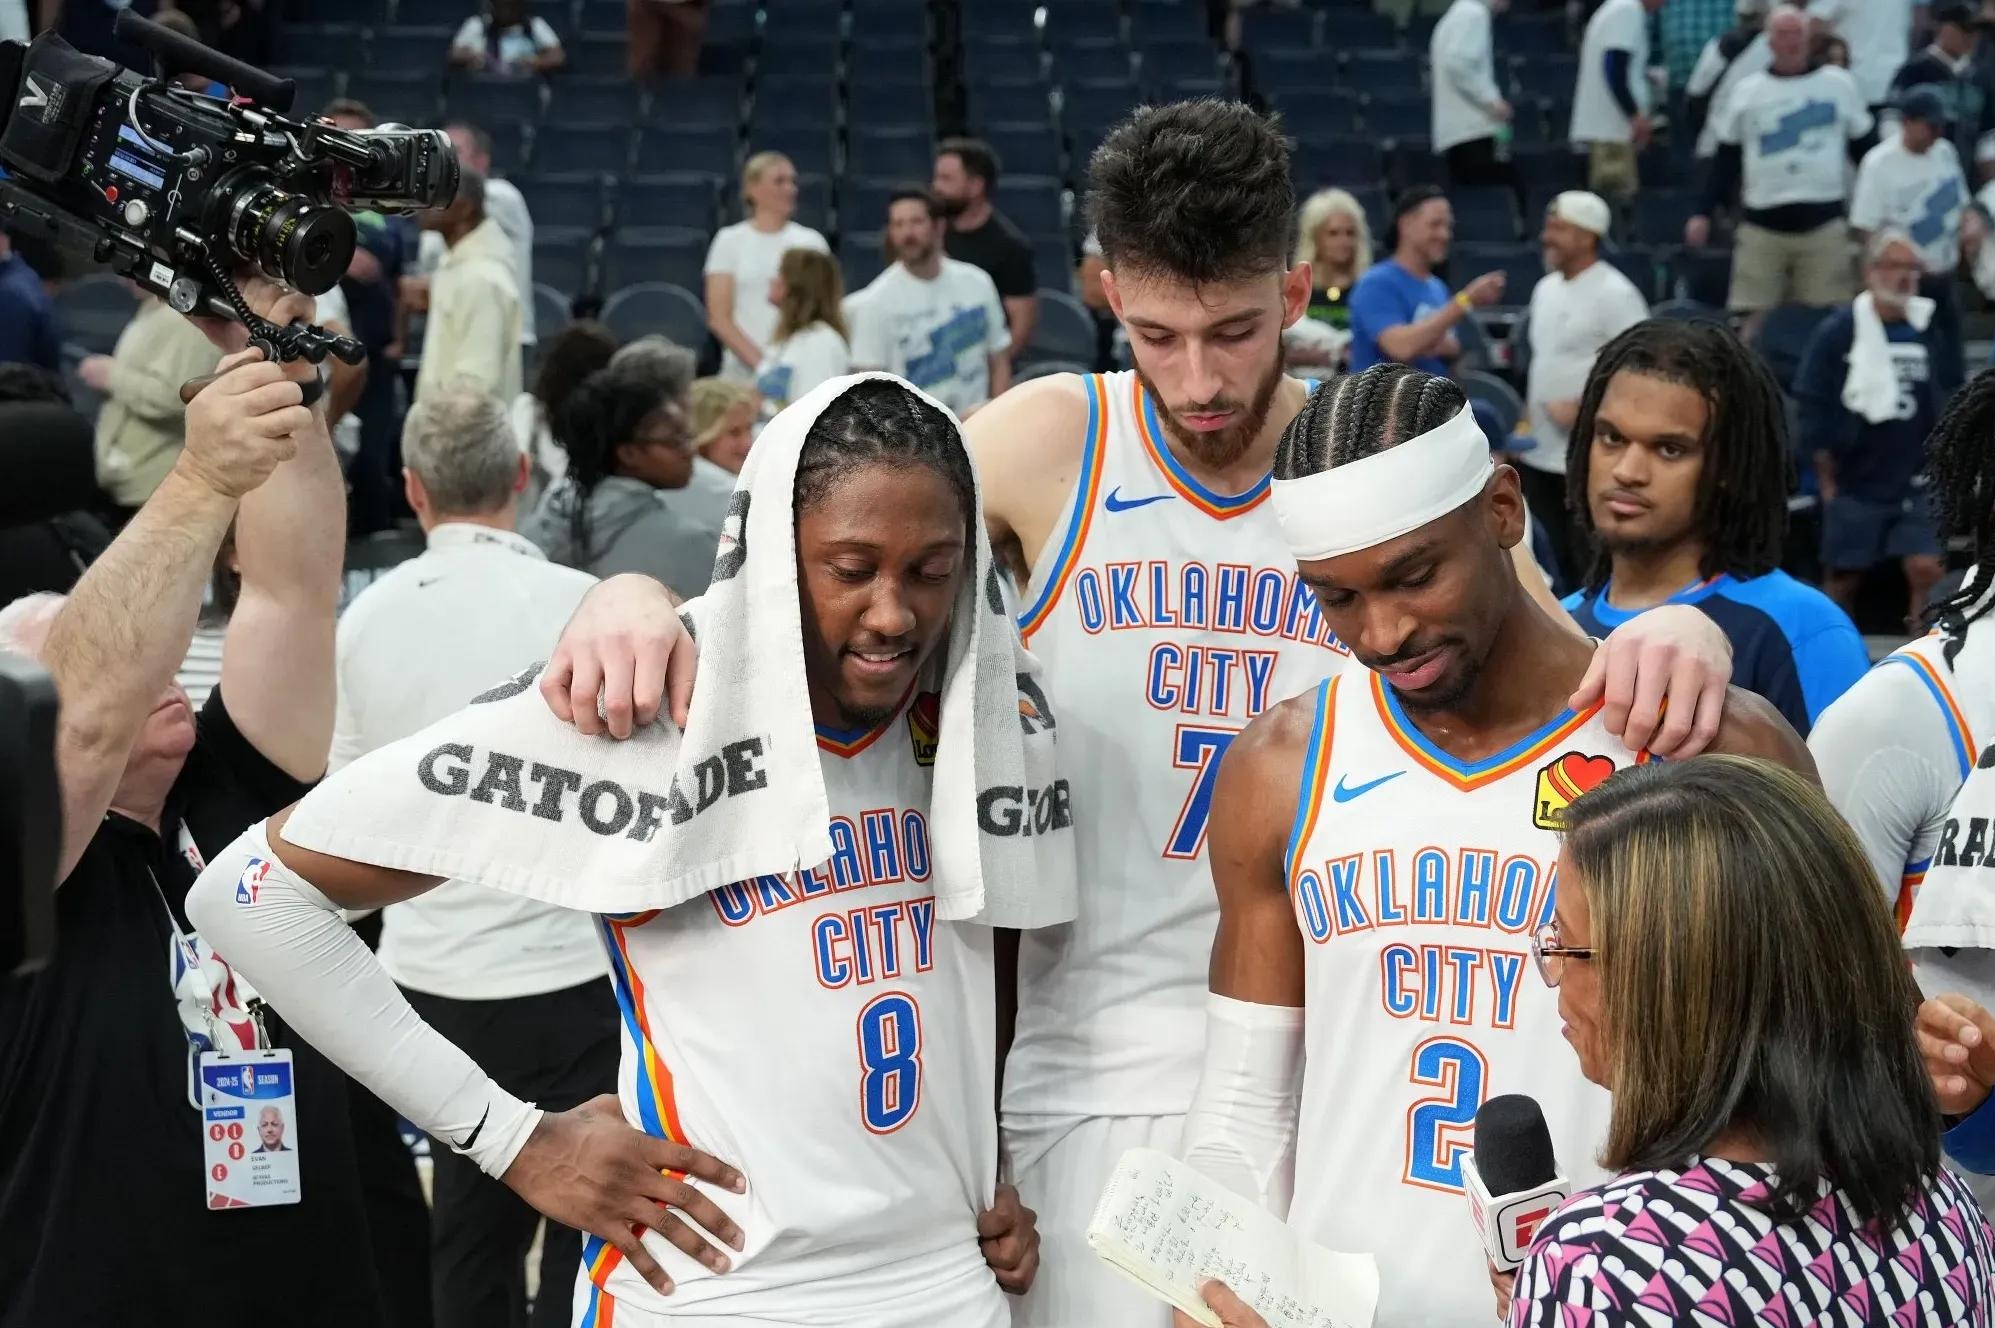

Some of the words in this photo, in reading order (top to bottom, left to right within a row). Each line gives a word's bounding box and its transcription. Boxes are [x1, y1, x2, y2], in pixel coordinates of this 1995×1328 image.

[1146, 642, 1278, 718] CITY
[1162, 723, 1247, 860] 7
[707, 807, 935, 927] OKLAHO
[1297, 846, 1558, 944] OKLAHO
[812, 896, 935, 989] CITY
[1381, 943, 1527, 1029] CITY
[857, 991, 923, 1135] 8
[213, 1109, 238, 1117] VENDOR
[1402, 1036, 1488, 1195] 2
